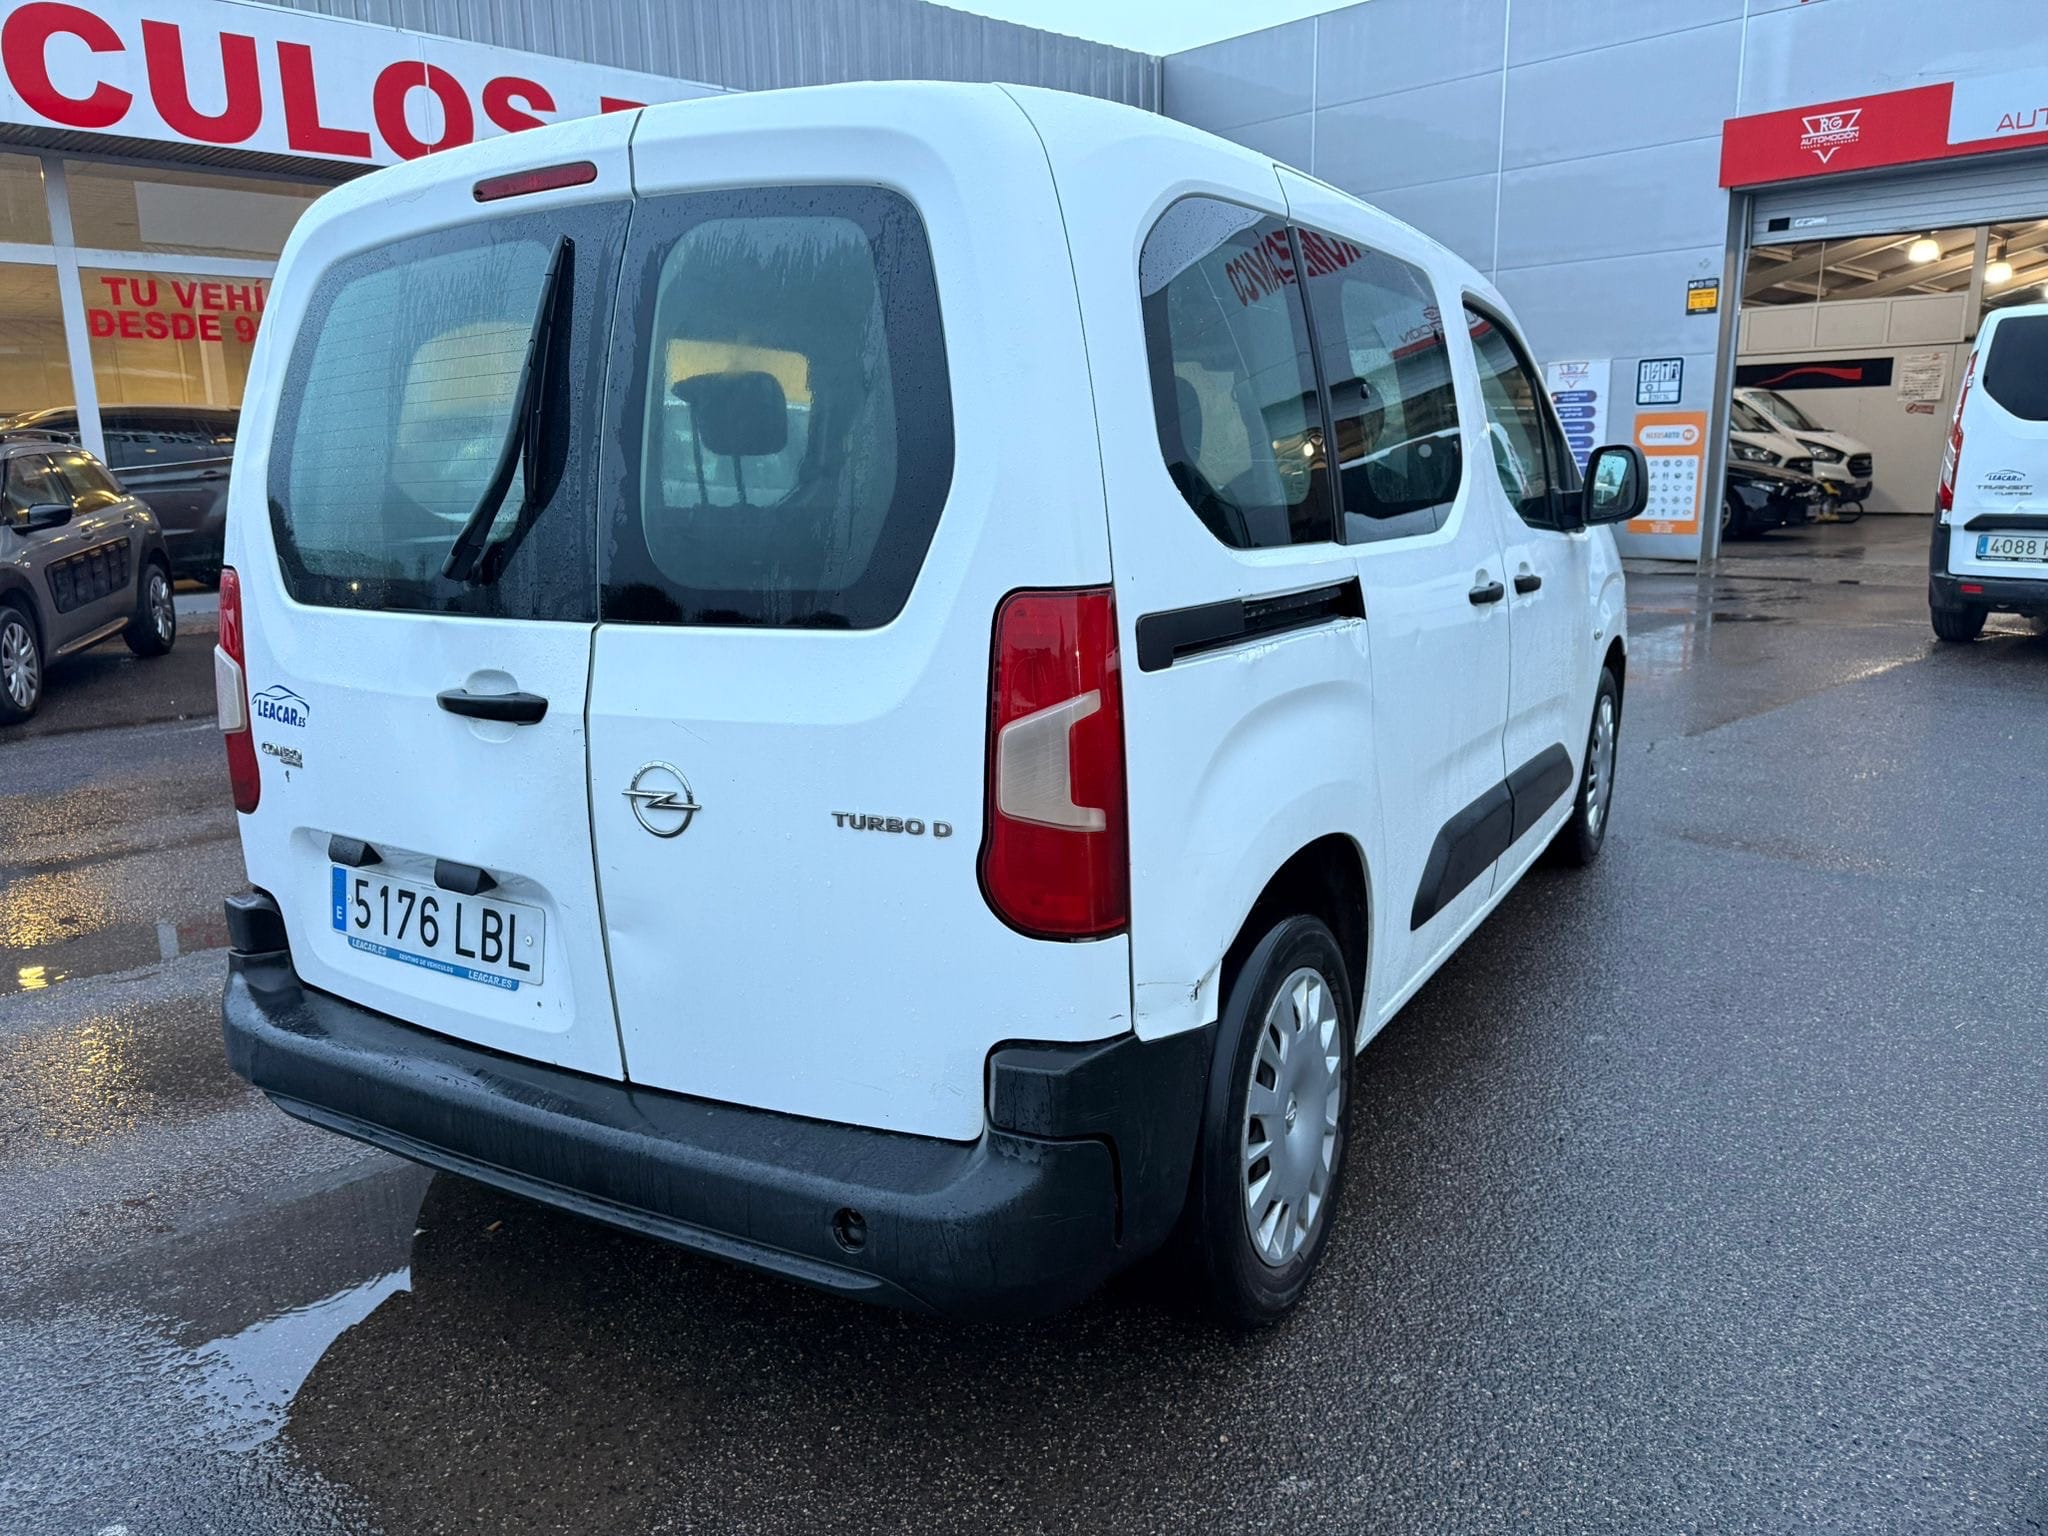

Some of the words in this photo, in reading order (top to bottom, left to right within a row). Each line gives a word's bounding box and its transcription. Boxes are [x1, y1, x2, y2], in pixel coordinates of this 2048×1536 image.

[101, 276, 158, 307] TU
[87, 309, 223, 342] DESDE
[234, 315, 261, 343] 9
[1990, 538, 2037, 555] 4088
[831, 810, 925, 836] TURBO
[932, 819, 953, 838] D
[355, 879, 440, 948] 5176
[455, 902, 531, 972] LBL
[468, 968, 512, 989] LEACAR.ES
